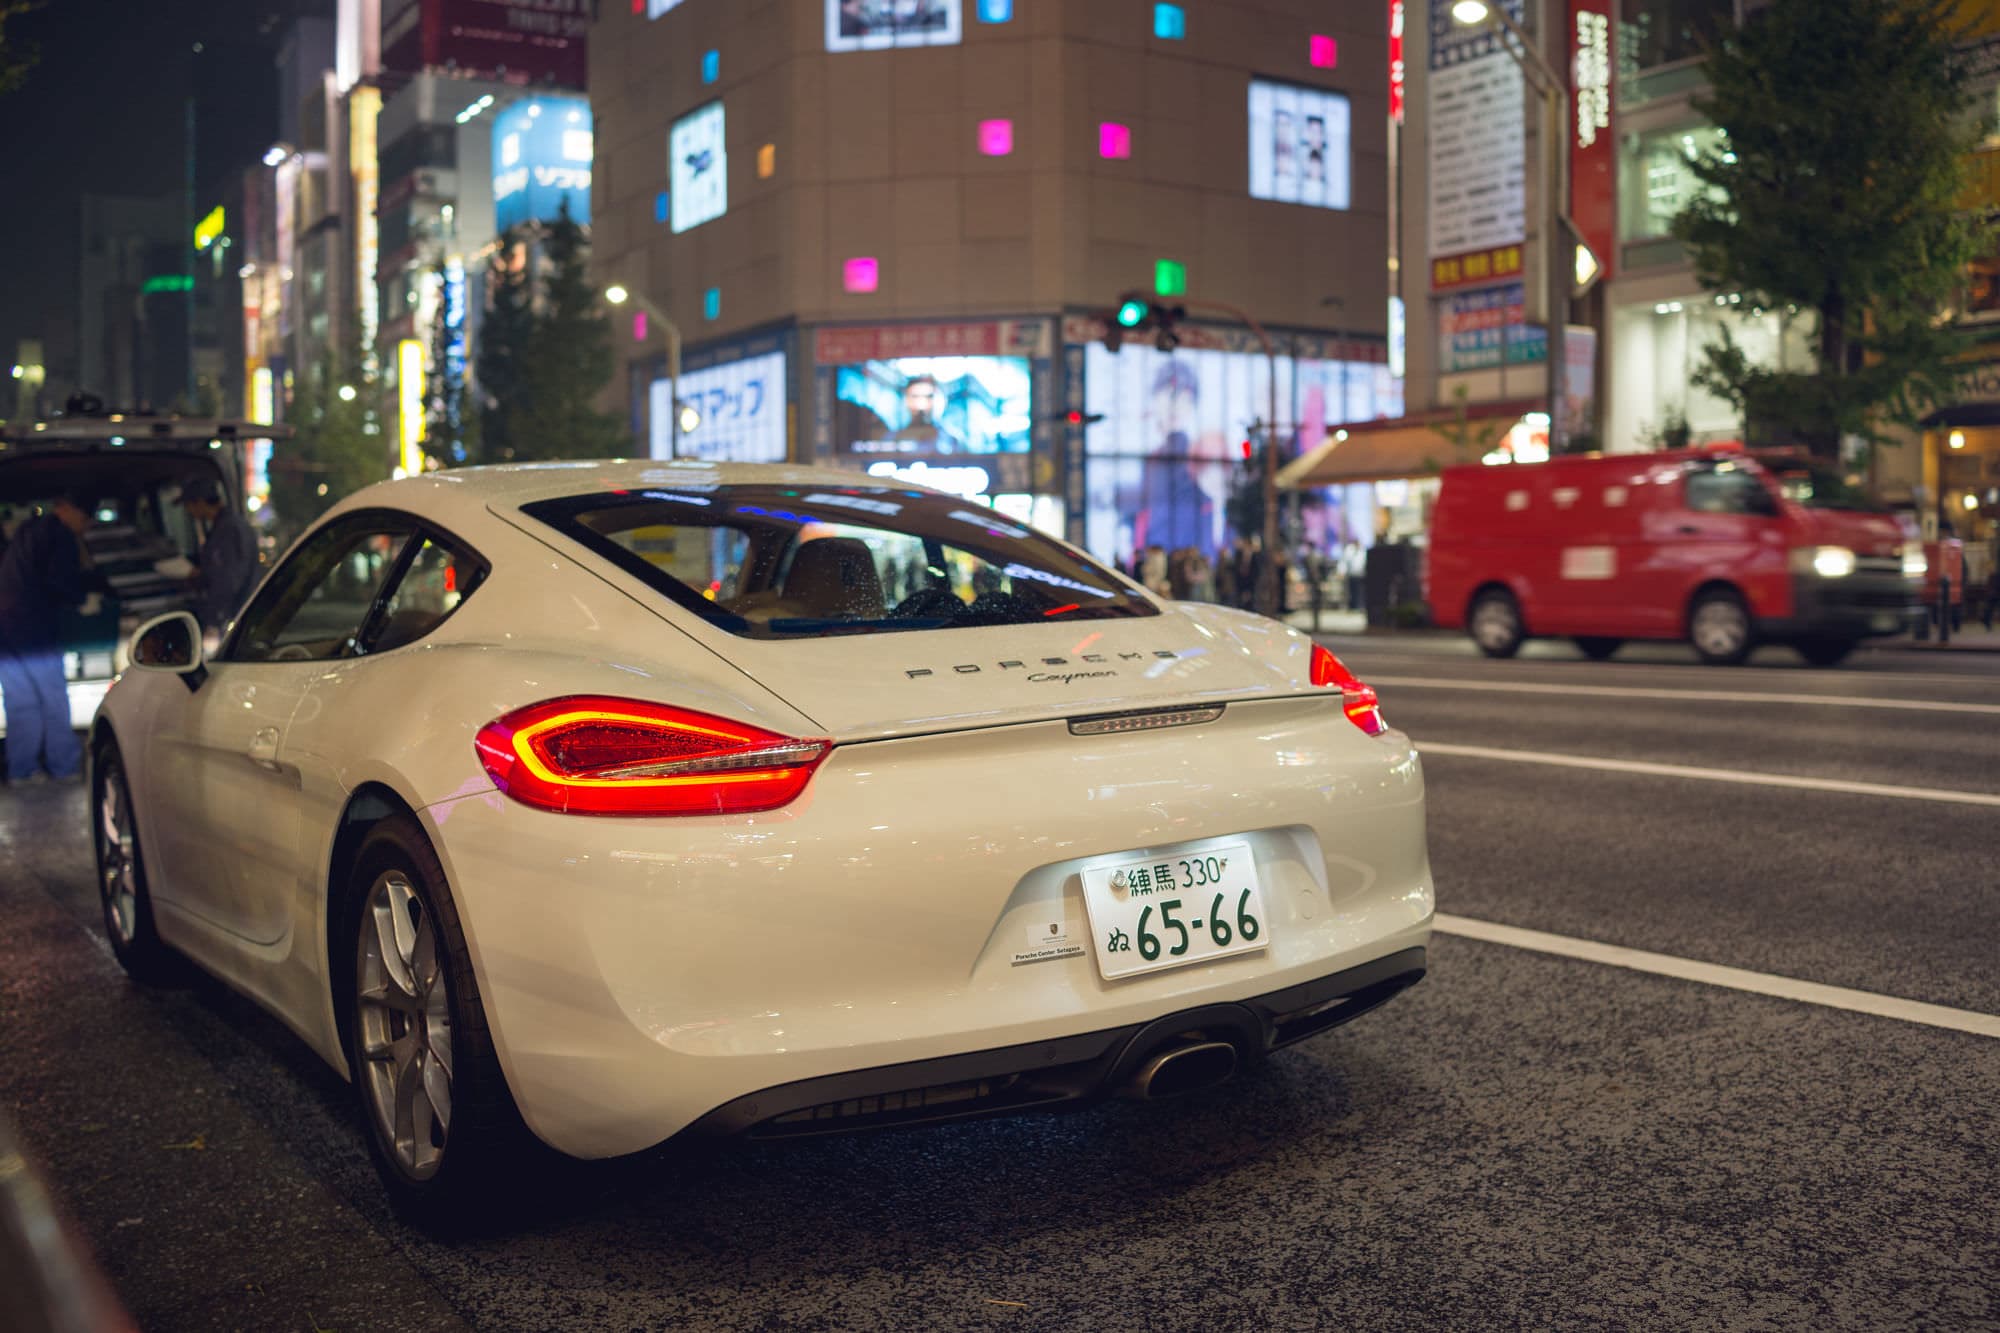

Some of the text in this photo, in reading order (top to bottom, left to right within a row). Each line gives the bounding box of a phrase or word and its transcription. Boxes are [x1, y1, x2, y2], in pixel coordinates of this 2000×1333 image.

[905, 650, 1178, 680] PORSCHE
[1027, 669, 1118, 684] Cayman
[1127, 856, 1221, 897] 練馬 330
[1107, 887, 1259, 961] ぬ 65-66
[1015, 953, 1037, 961] Porsche
[1056, 946, 1081, 954] Setagaya
